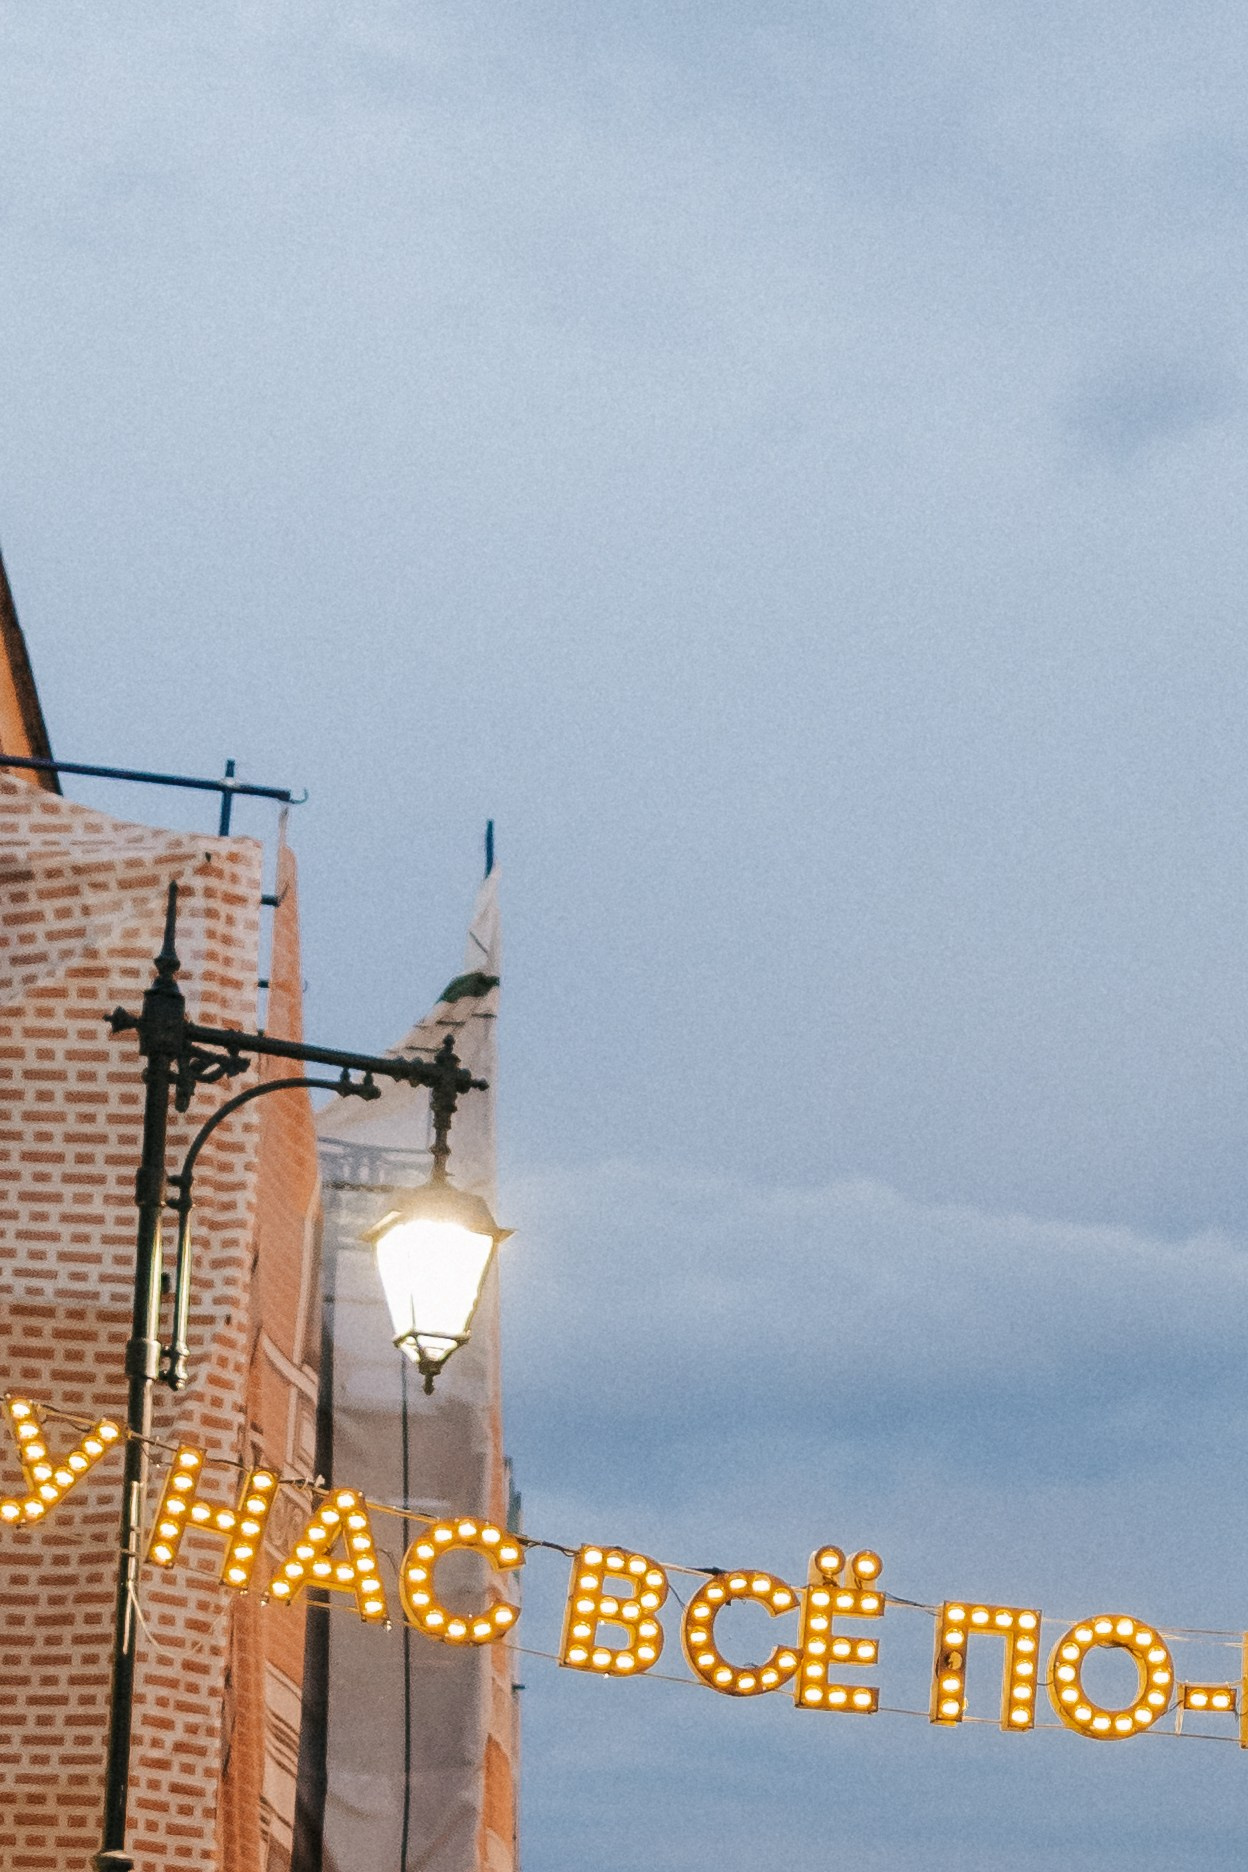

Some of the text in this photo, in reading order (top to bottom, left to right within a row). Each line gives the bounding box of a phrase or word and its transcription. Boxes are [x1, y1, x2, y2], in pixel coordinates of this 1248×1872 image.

[0, 1396, 126, 1527] У
[144, 1443, 527, 1648] НАС
[558, 1544, 886, 1714] ВСЁ
